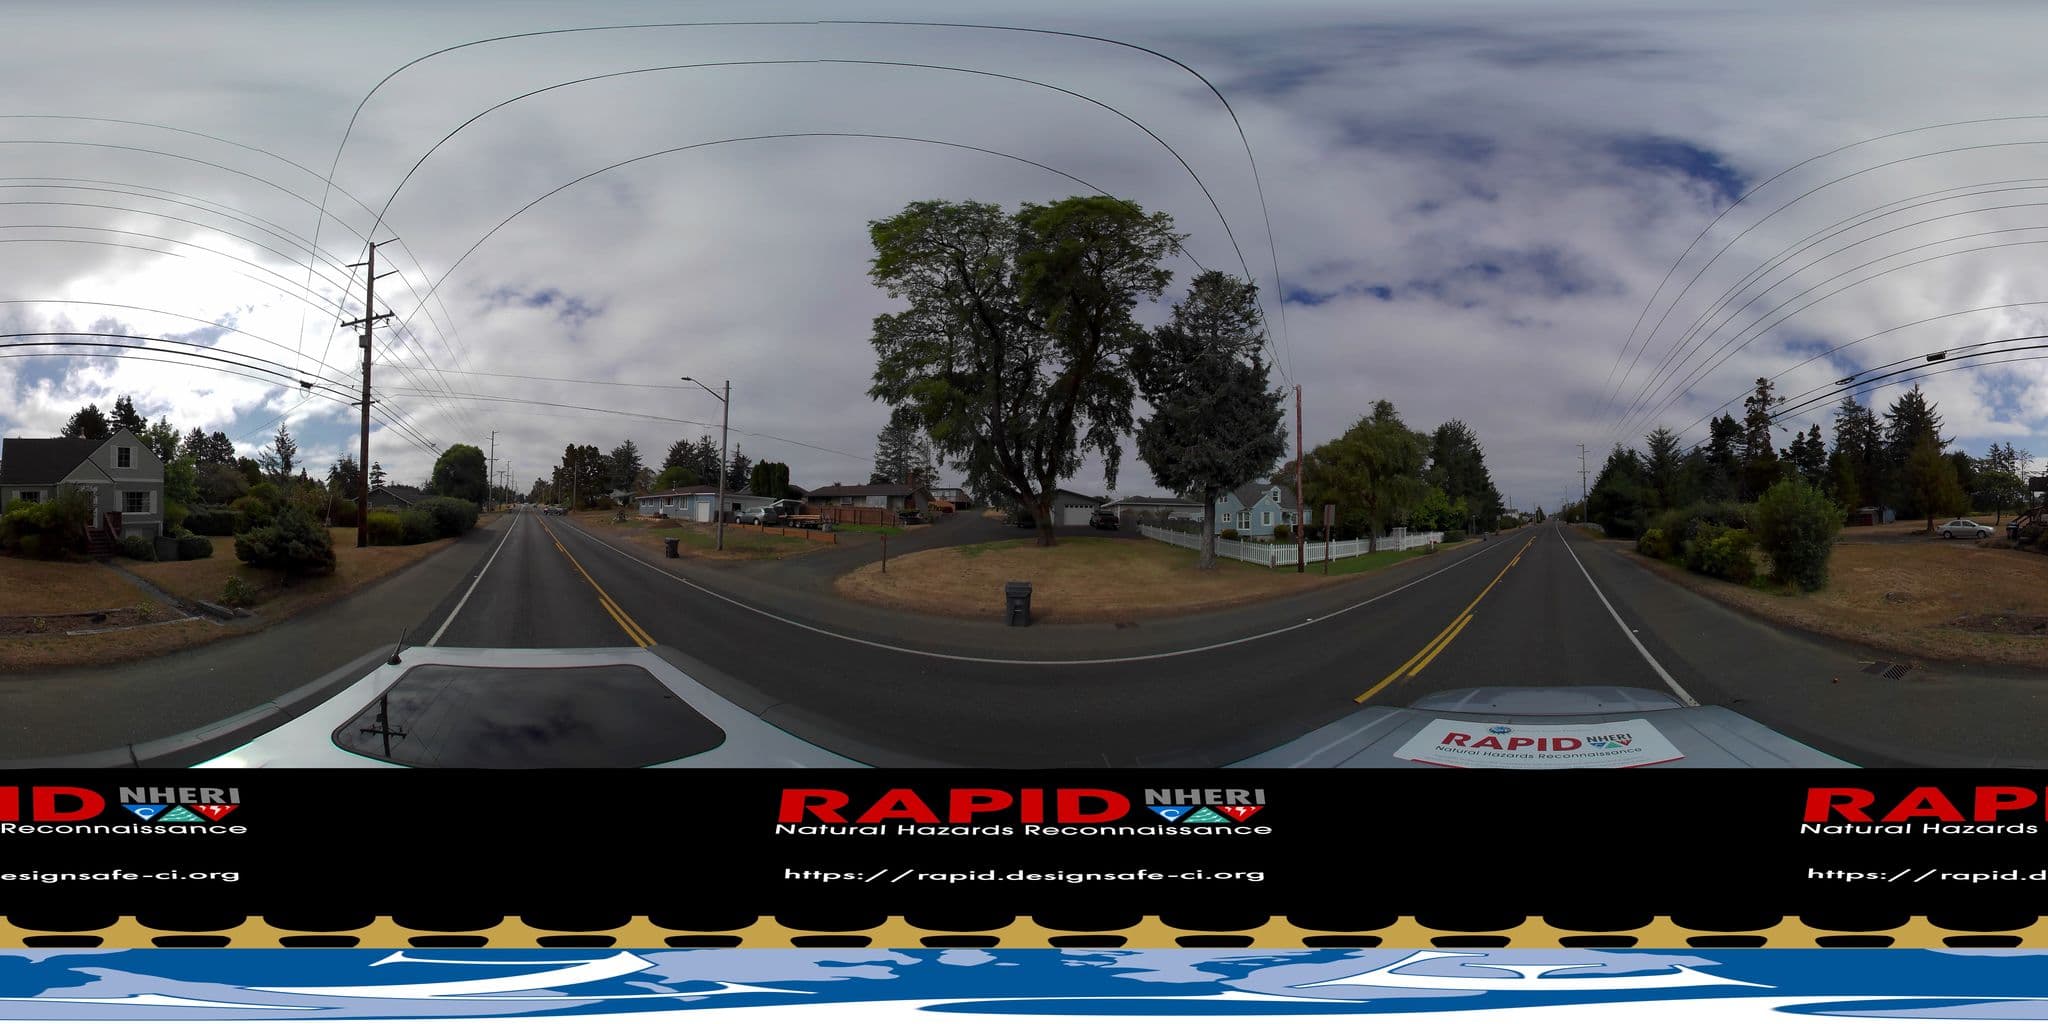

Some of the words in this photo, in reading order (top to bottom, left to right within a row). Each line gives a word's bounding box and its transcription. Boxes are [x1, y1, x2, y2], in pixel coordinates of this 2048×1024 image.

[1441, 732, 1582, 752] RAPID
[1587, 733, 1632, 744] NHERI
[1435, 745, 1480, 756] Natural
[1483, 751, 1535, 759] Hazards
[1538, 747, 1642, 759] Reconnaissance
